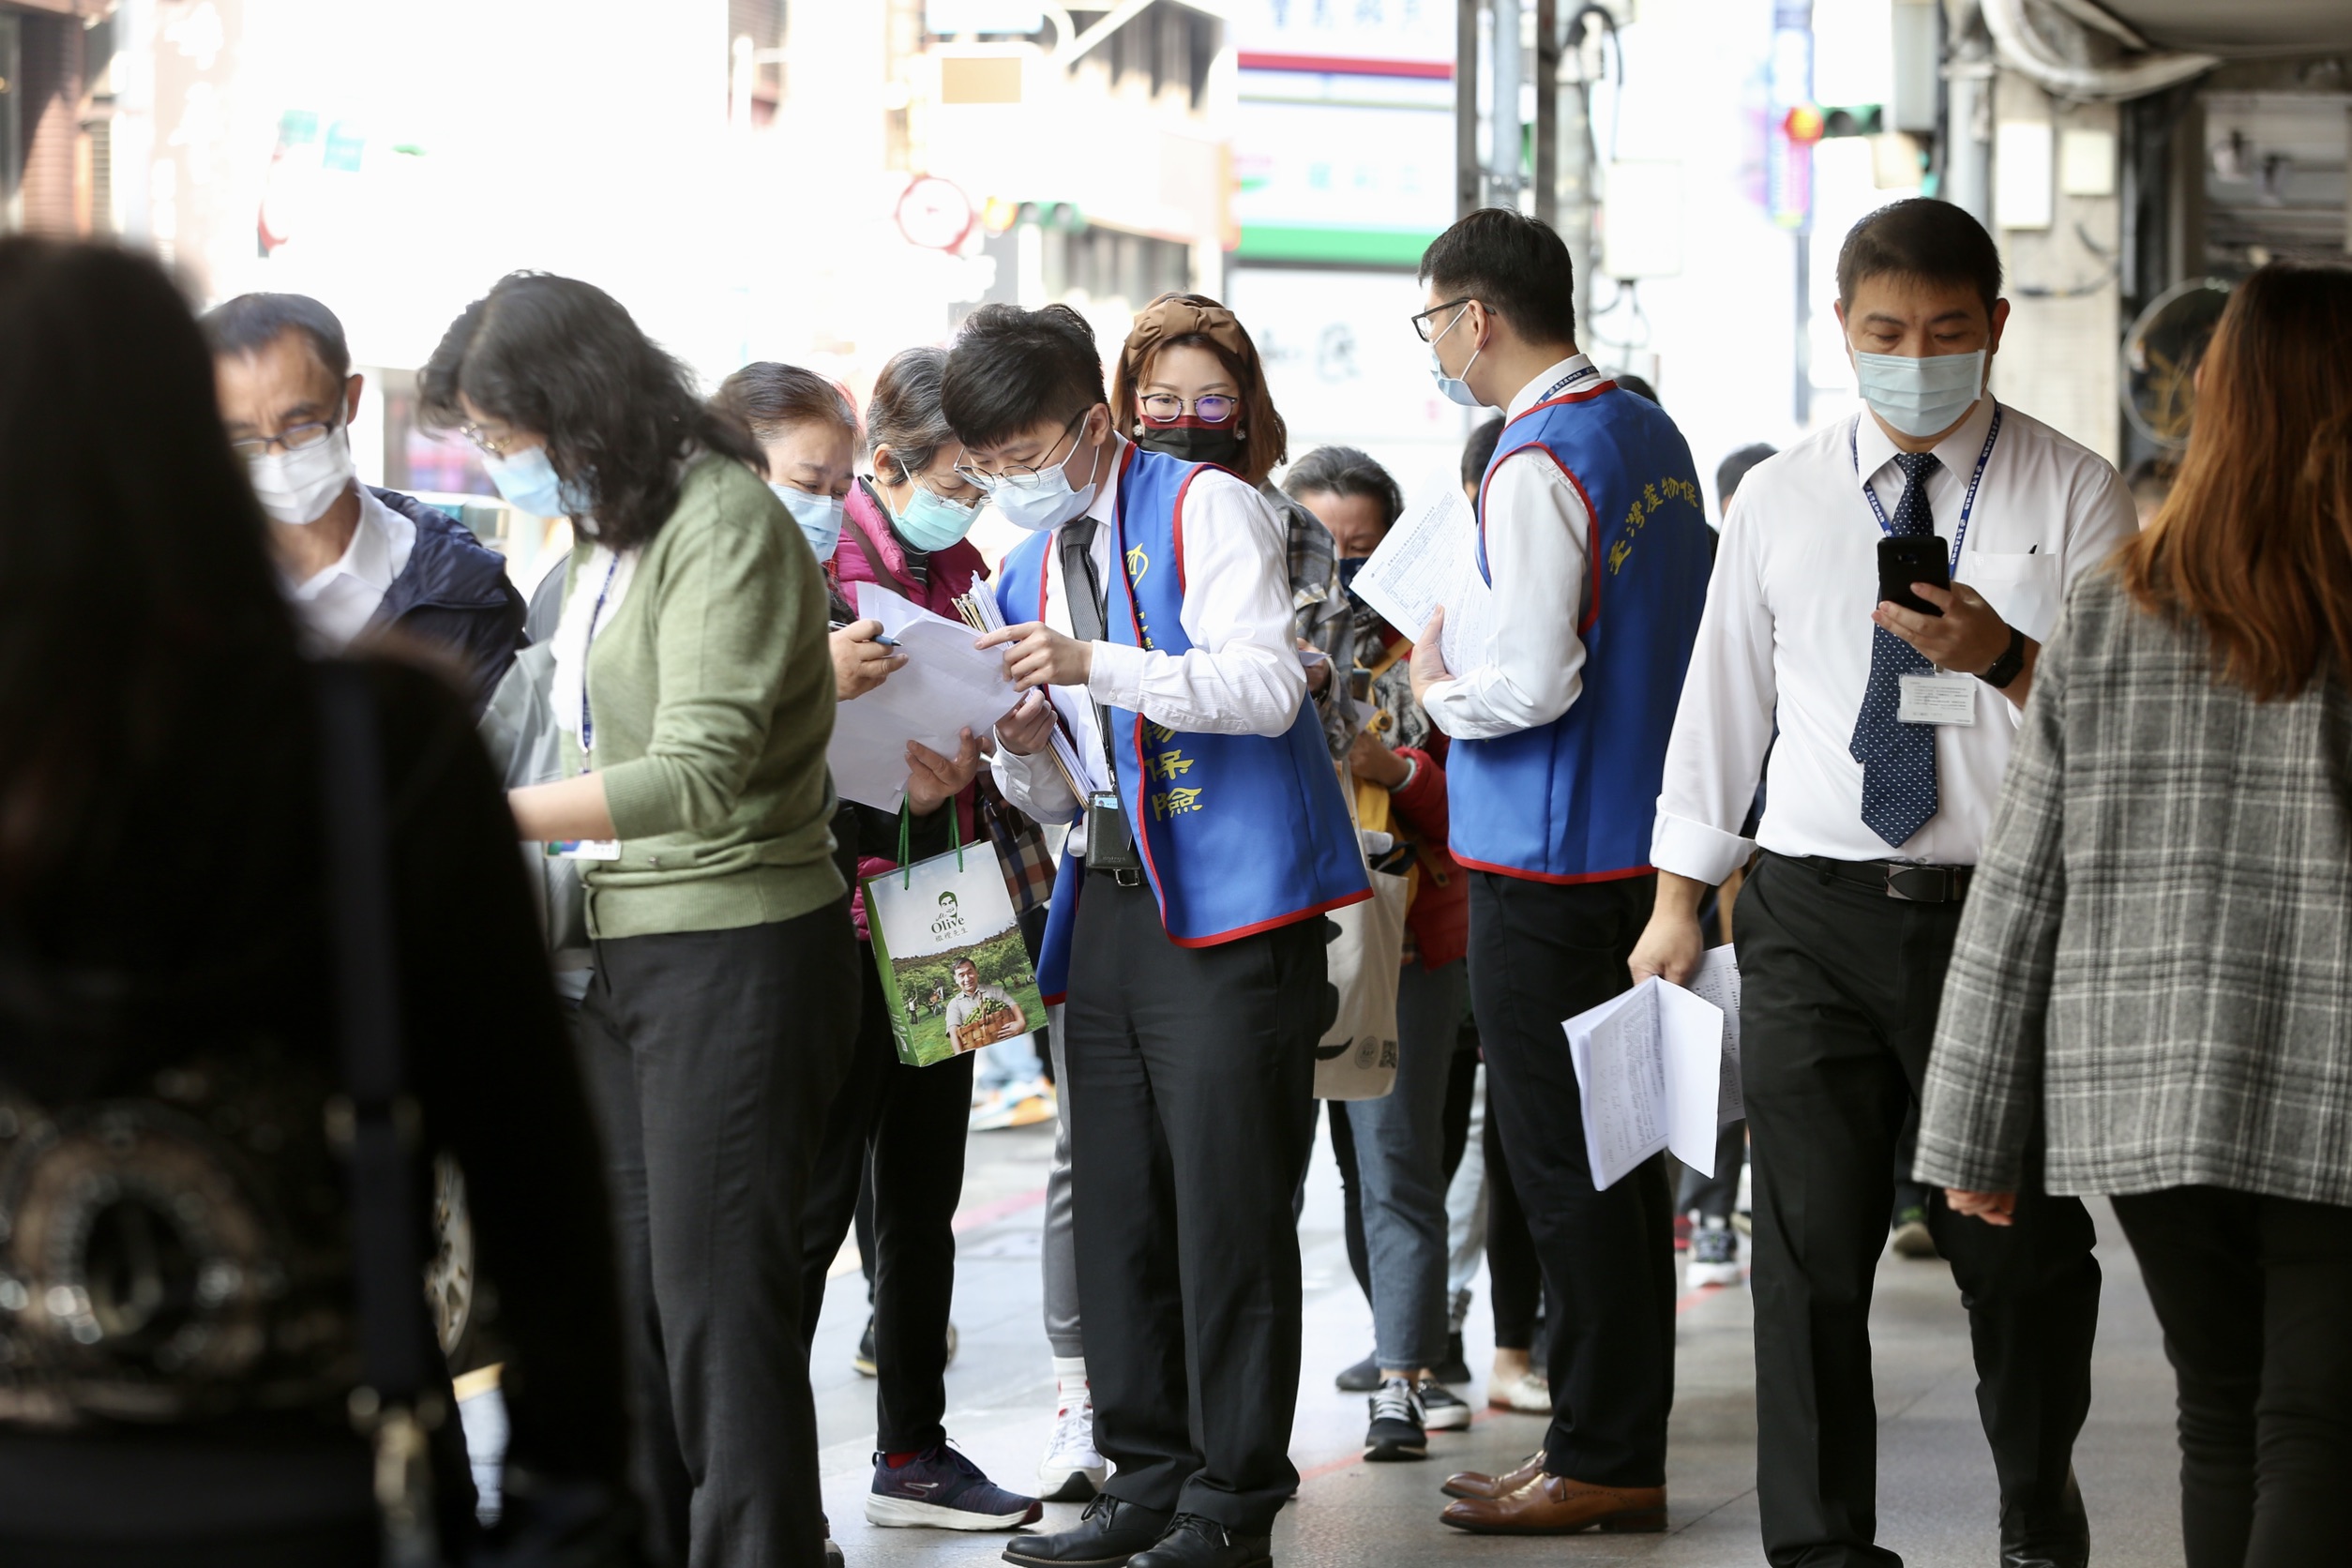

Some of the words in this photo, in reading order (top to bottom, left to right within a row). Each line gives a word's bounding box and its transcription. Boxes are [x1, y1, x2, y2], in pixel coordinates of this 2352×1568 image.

[1608, 476, 1704, 576] 臺灣產物保
[930, 917, 966, 934] Olive
